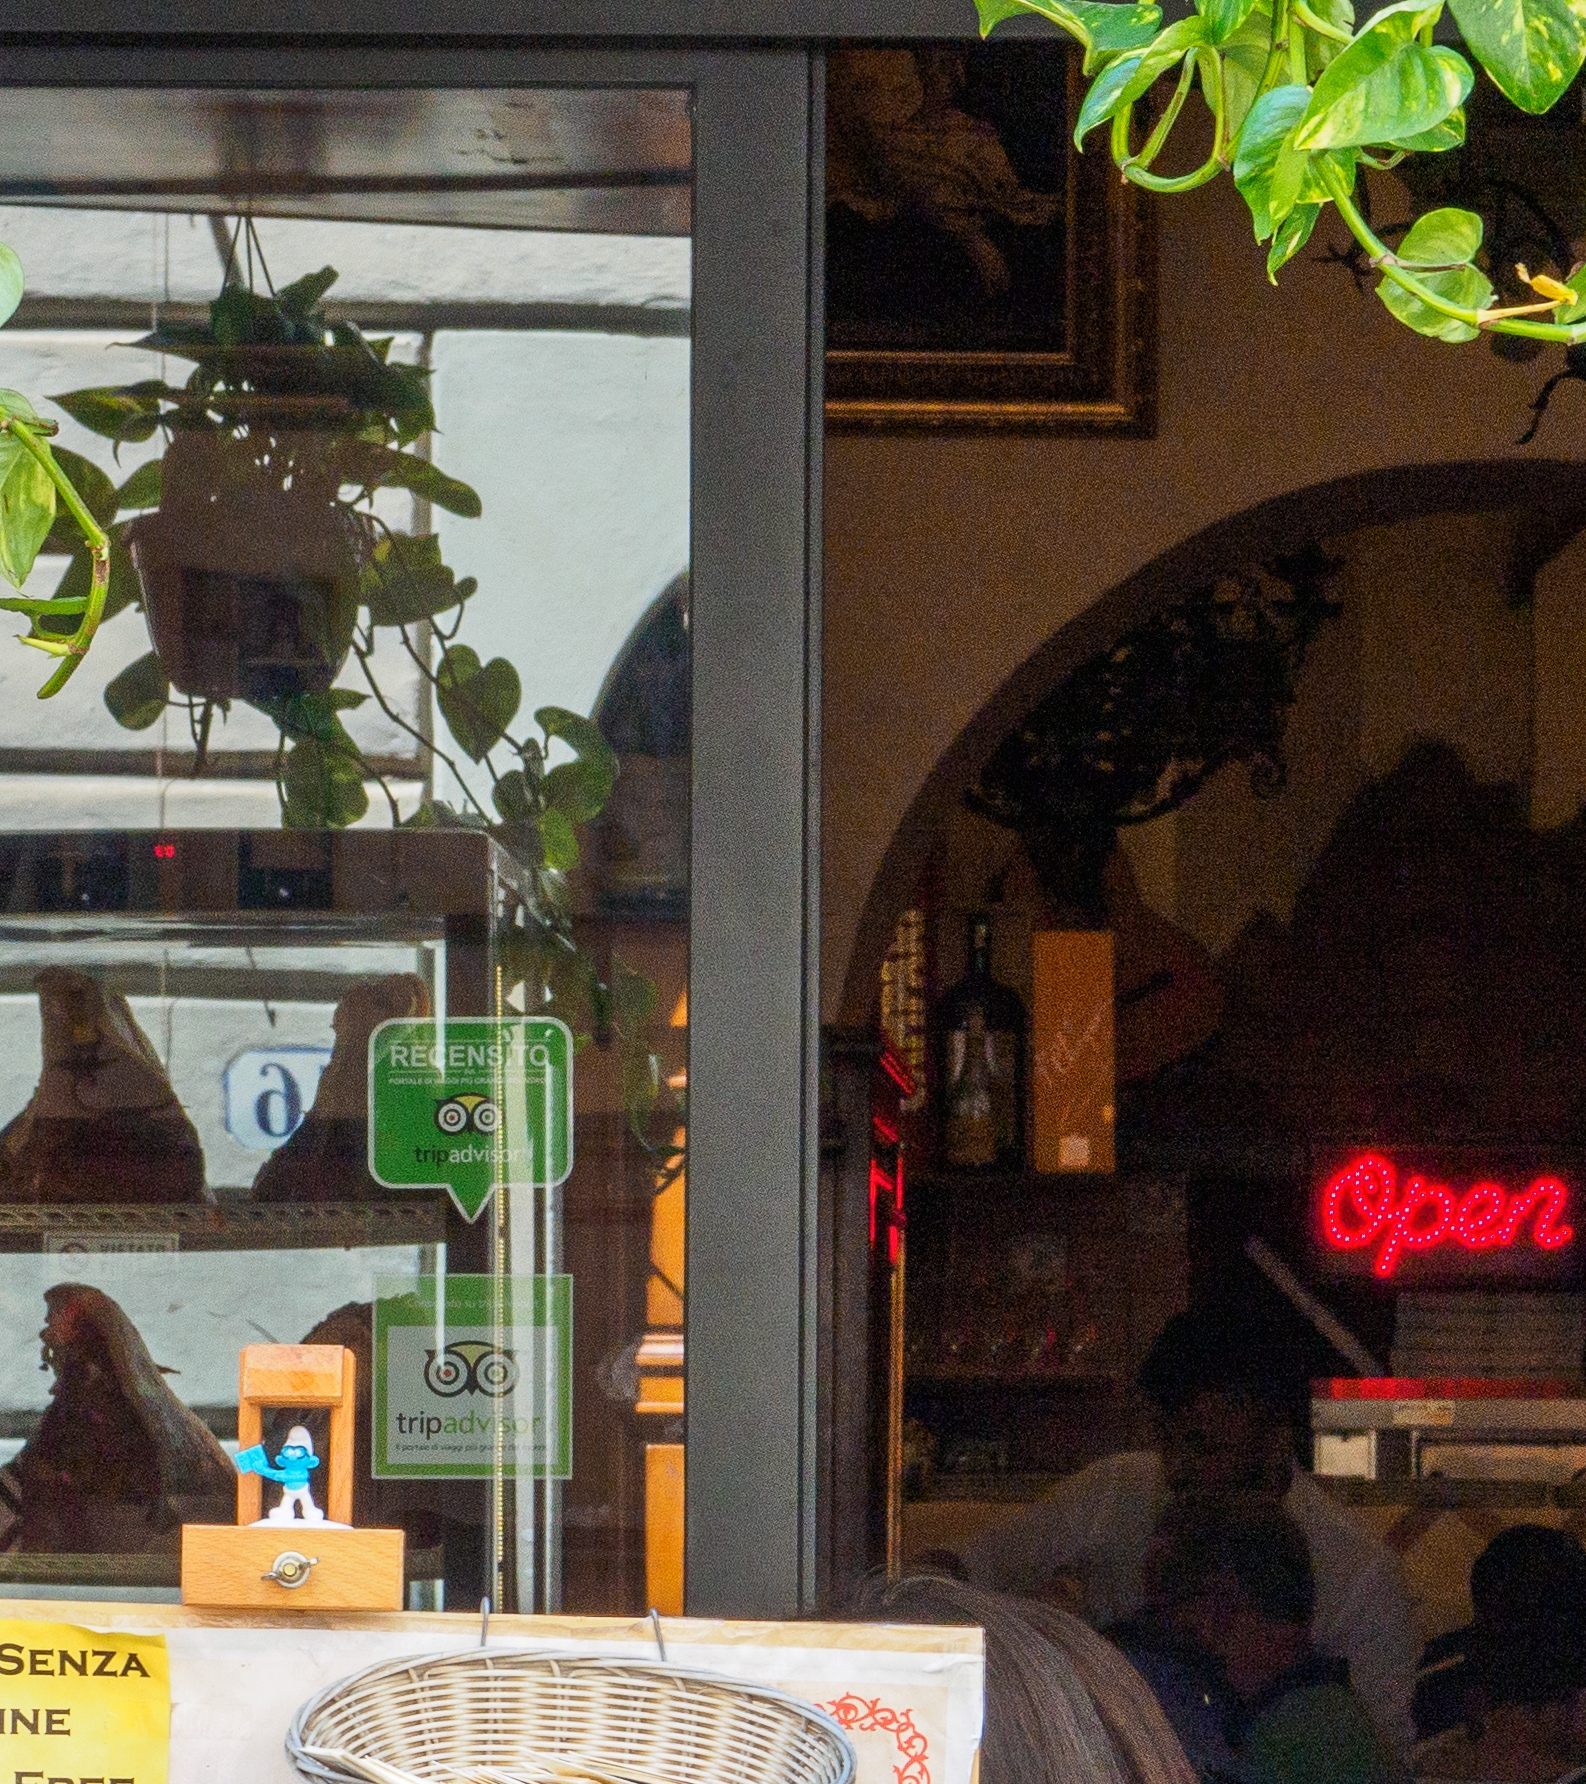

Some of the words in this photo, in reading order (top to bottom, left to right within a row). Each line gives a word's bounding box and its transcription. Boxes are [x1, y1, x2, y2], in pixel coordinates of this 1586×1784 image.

[390, 1044, 551, 1068] RECENSITO
[1321, 1152, 1573, 1278] Open
[396, 1410, 541, 1440] tripadvisor
